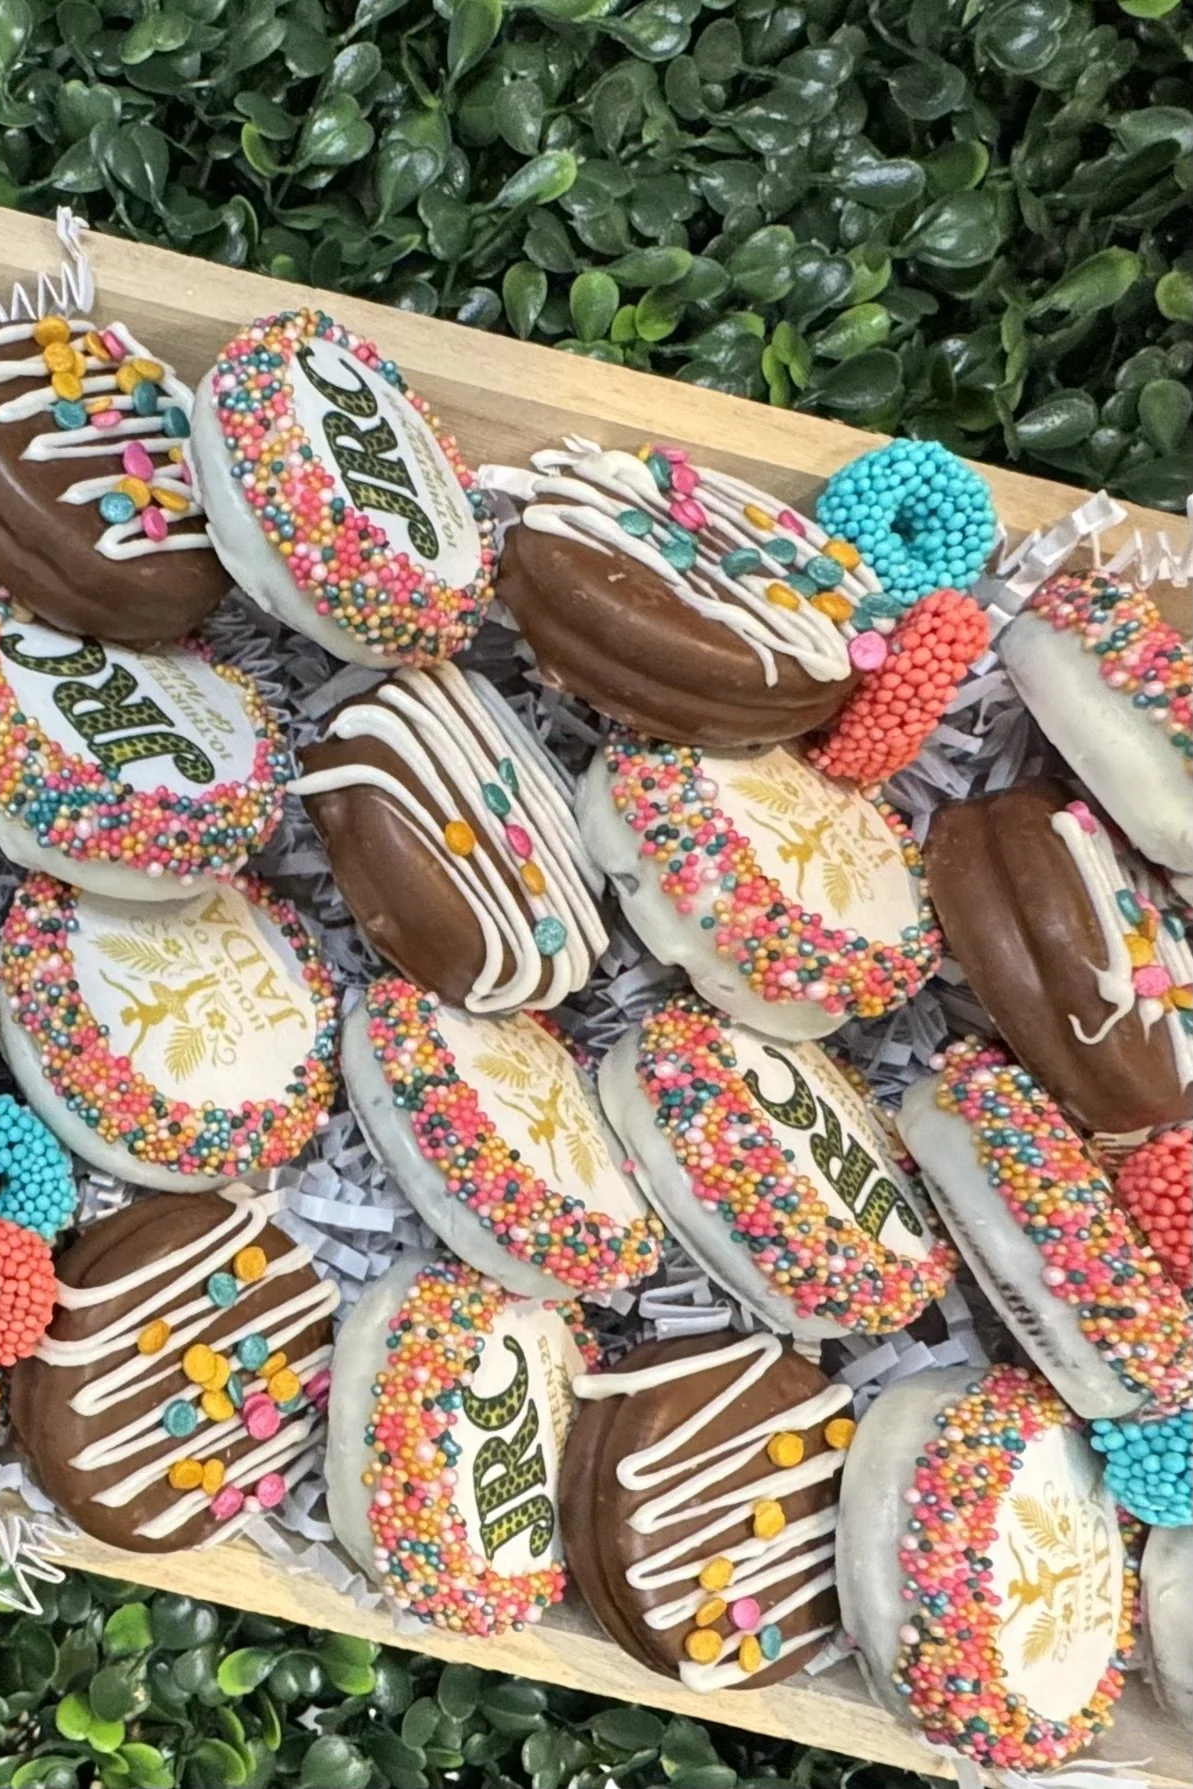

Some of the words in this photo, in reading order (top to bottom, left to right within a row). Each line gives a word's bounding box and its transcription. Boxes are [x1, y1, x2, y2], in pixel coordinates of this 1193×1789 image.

[296, 339, 439, 560] JRC
[199, 892, 308, 1030] JADA
[209, 954, 266, 1033] HOUSE
[743, 1045, 923, 1242] JRC
[458, 1334, 555, 1561] JRC
